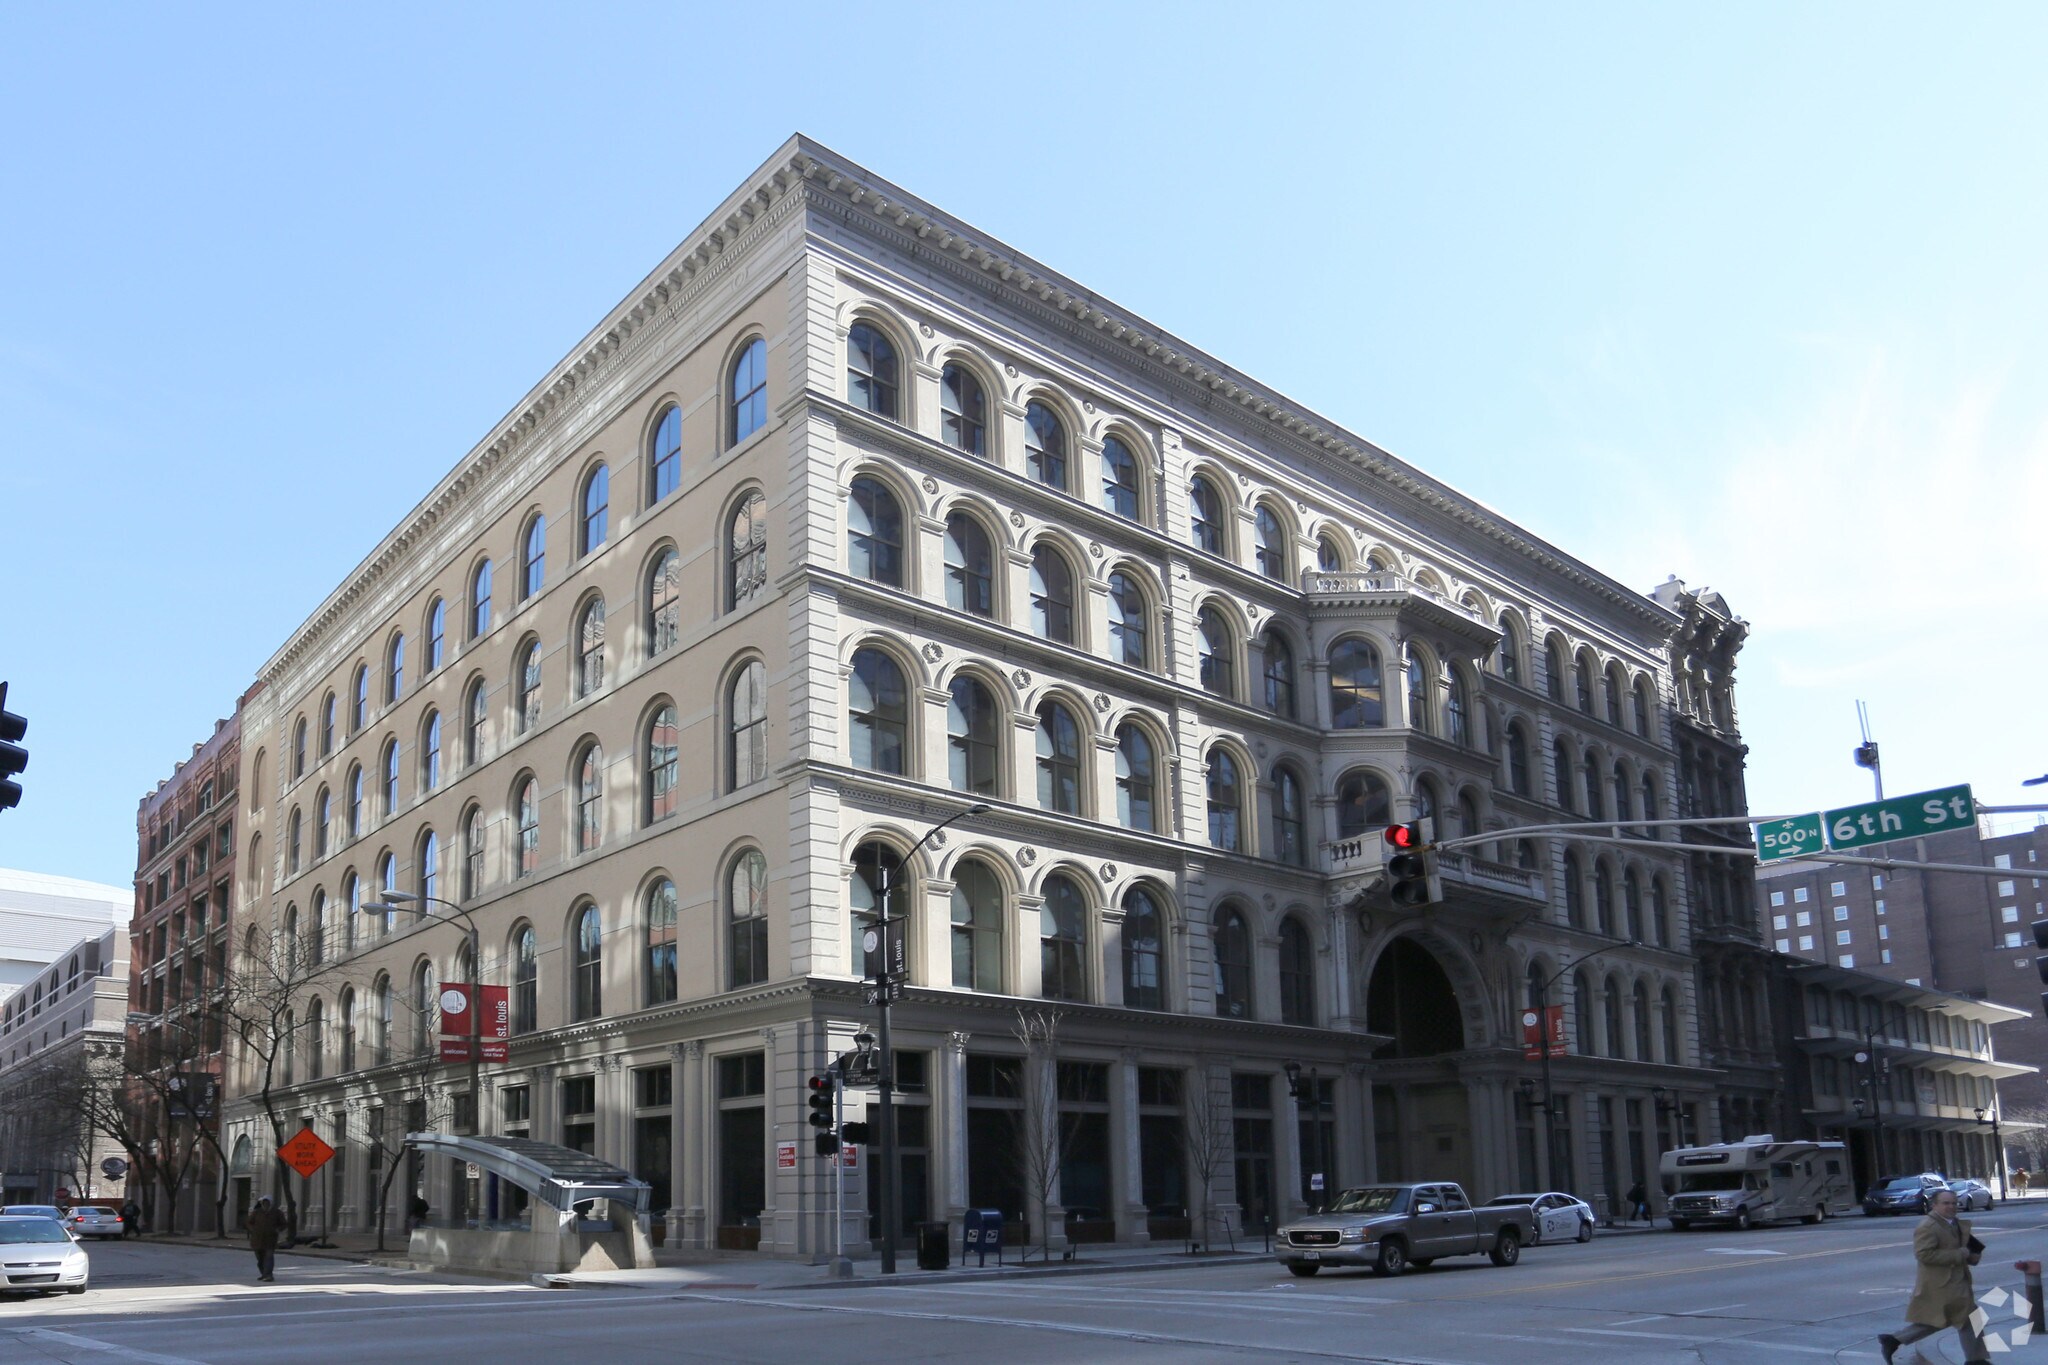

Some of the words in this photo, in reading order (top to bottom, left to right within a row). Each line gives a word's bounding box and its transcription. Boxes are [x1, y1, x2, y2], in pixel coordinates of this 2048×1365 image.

[1833, 810, 1902, 841] 6th
[1923, 795, 1968, 825] St
[1763, 829, 1806, 848] 500
[1809, 828, 1817, 838] N
[496, 1001, 506, 1023] louis
[496, 1025, 506, 1037] st.
